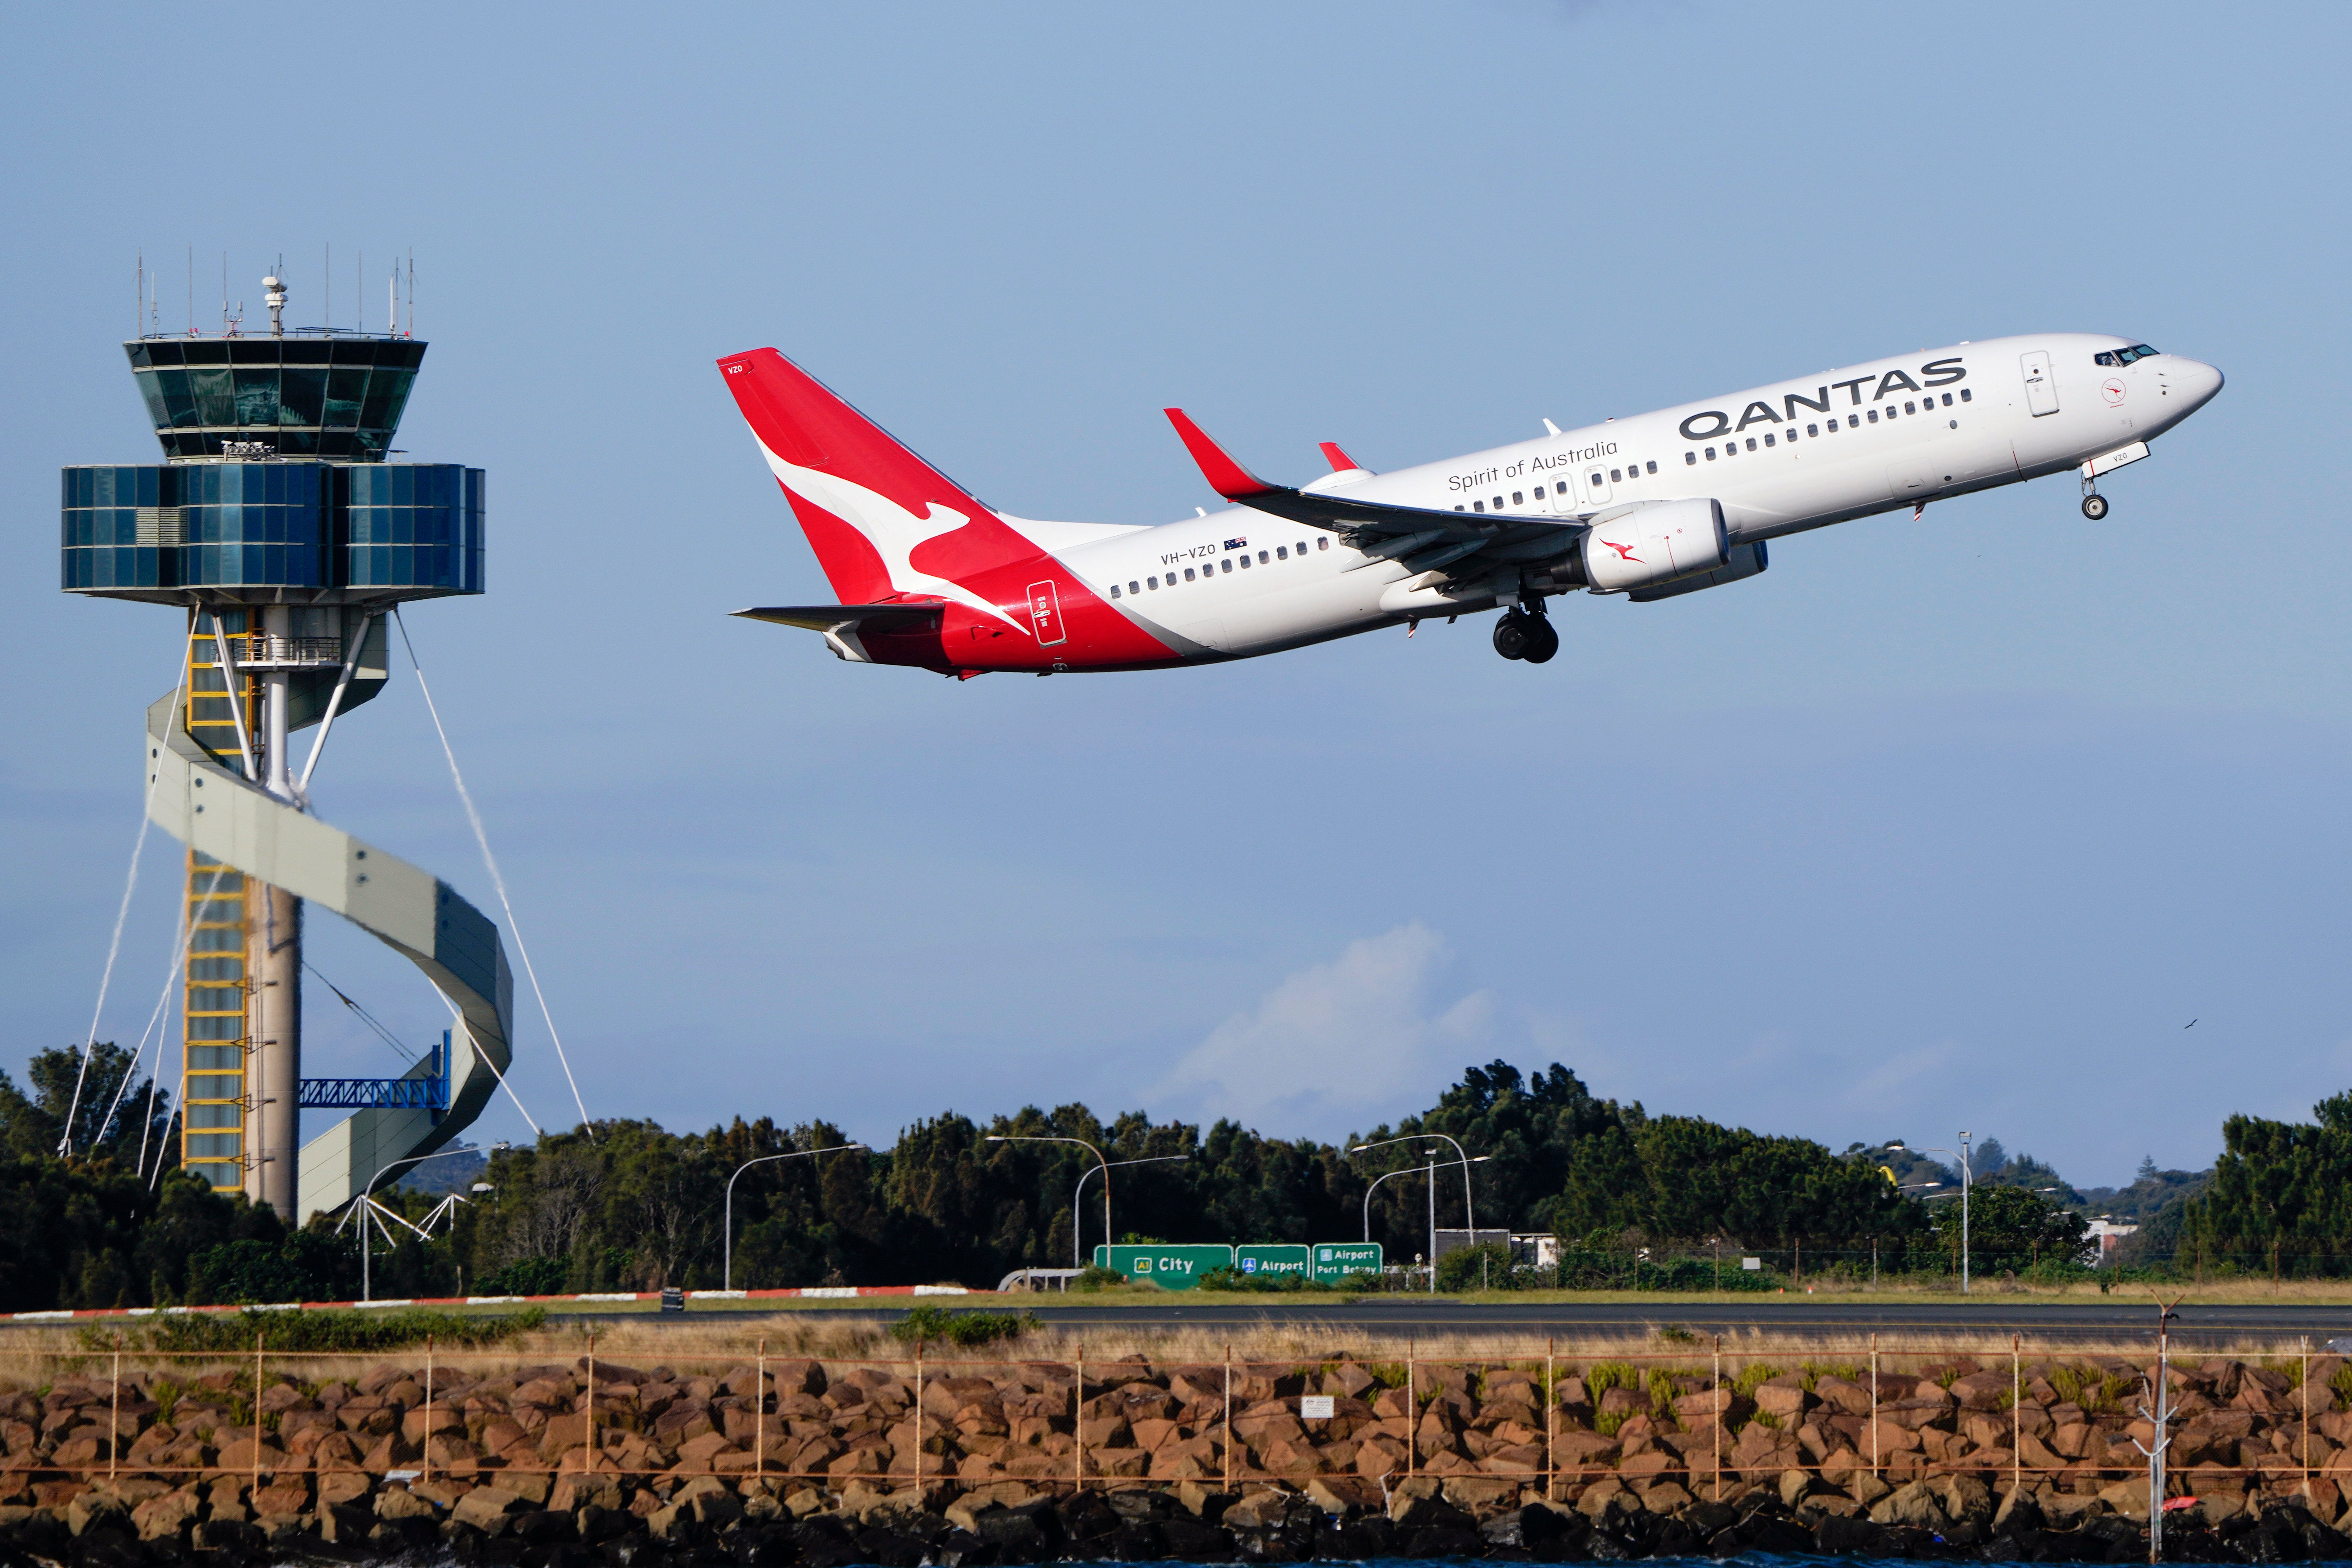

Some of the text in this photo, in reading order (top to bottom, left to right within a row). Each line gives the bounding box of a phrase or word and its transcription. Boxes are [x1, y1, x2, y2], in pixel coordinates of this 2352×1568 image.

[728, 365, 743, 374] VZO
[1679, 358, 1966, 440] QANTAS
[2113, 453, 2127, 462] VZO
[1449, 442, 1617, 492] Spirit of Australia
[1161, 544, 1215, 565] VH-VZO
[1335, 1250, 1374, 1261] Airport
[1138, 1261, 1149, 1269] A1
[1159, 1257, 1194, 1274] City
[1261, 1260, 1303, 1273] Airport
